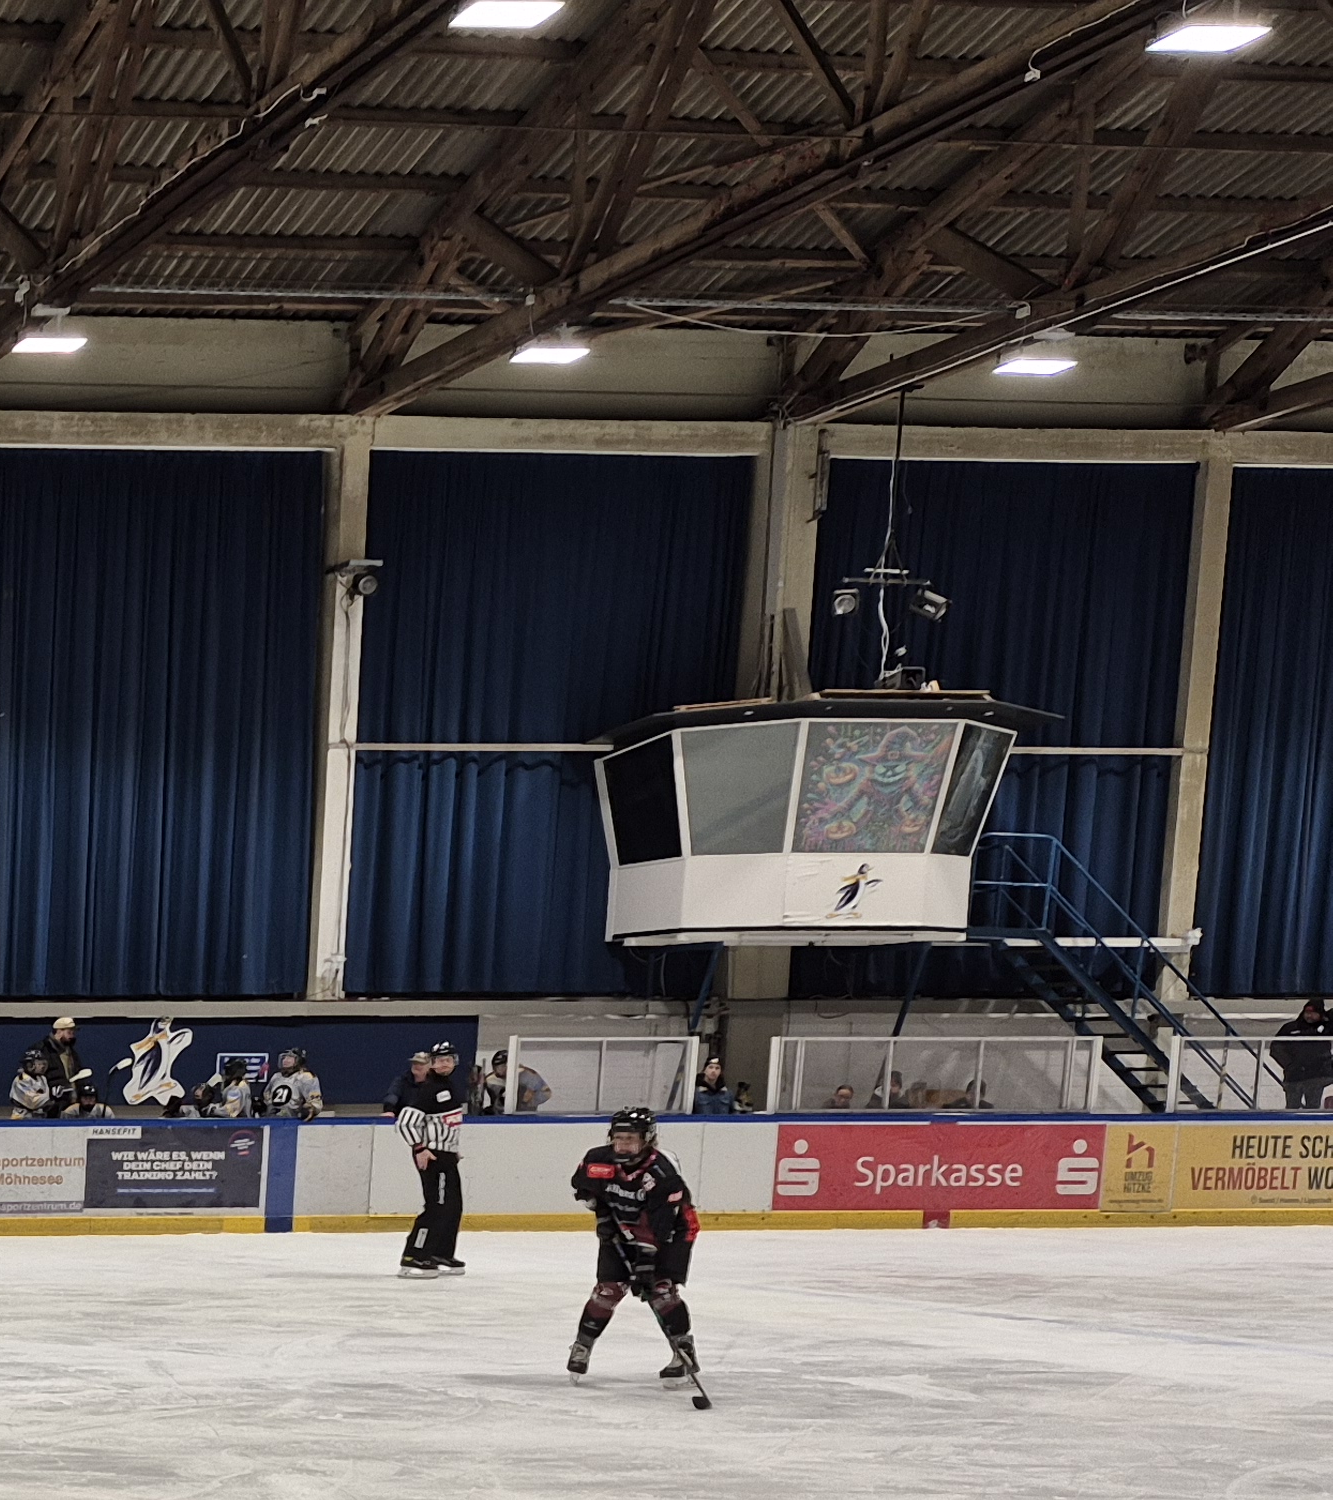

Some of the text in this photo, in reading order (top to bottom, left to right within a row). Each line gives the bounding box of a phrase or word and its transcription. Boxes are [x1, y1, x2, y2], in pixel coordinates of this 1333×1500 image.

[273, 1088, 288, 1103] 21
[91, 1127, 137, 1136] HANSEFIT
[1232, 1135, 1293, 1159] HEUTE
[111, 1150, 135, 1160] WIE
[137, 1148, 171, 1161] WÄRE
[191, 1150, 226, 1161] WENN
[123, 1161, 213, 1171] DEIN CHEF DEIN
[116, 1171, 174, 1180] TRAINING
[853, 1155, 1023, 1193] Sparkasse
[1124, 1171, 1153, 1182] UMZUG
[1190, 1163, 1302, 1191] VERMÖBELT
